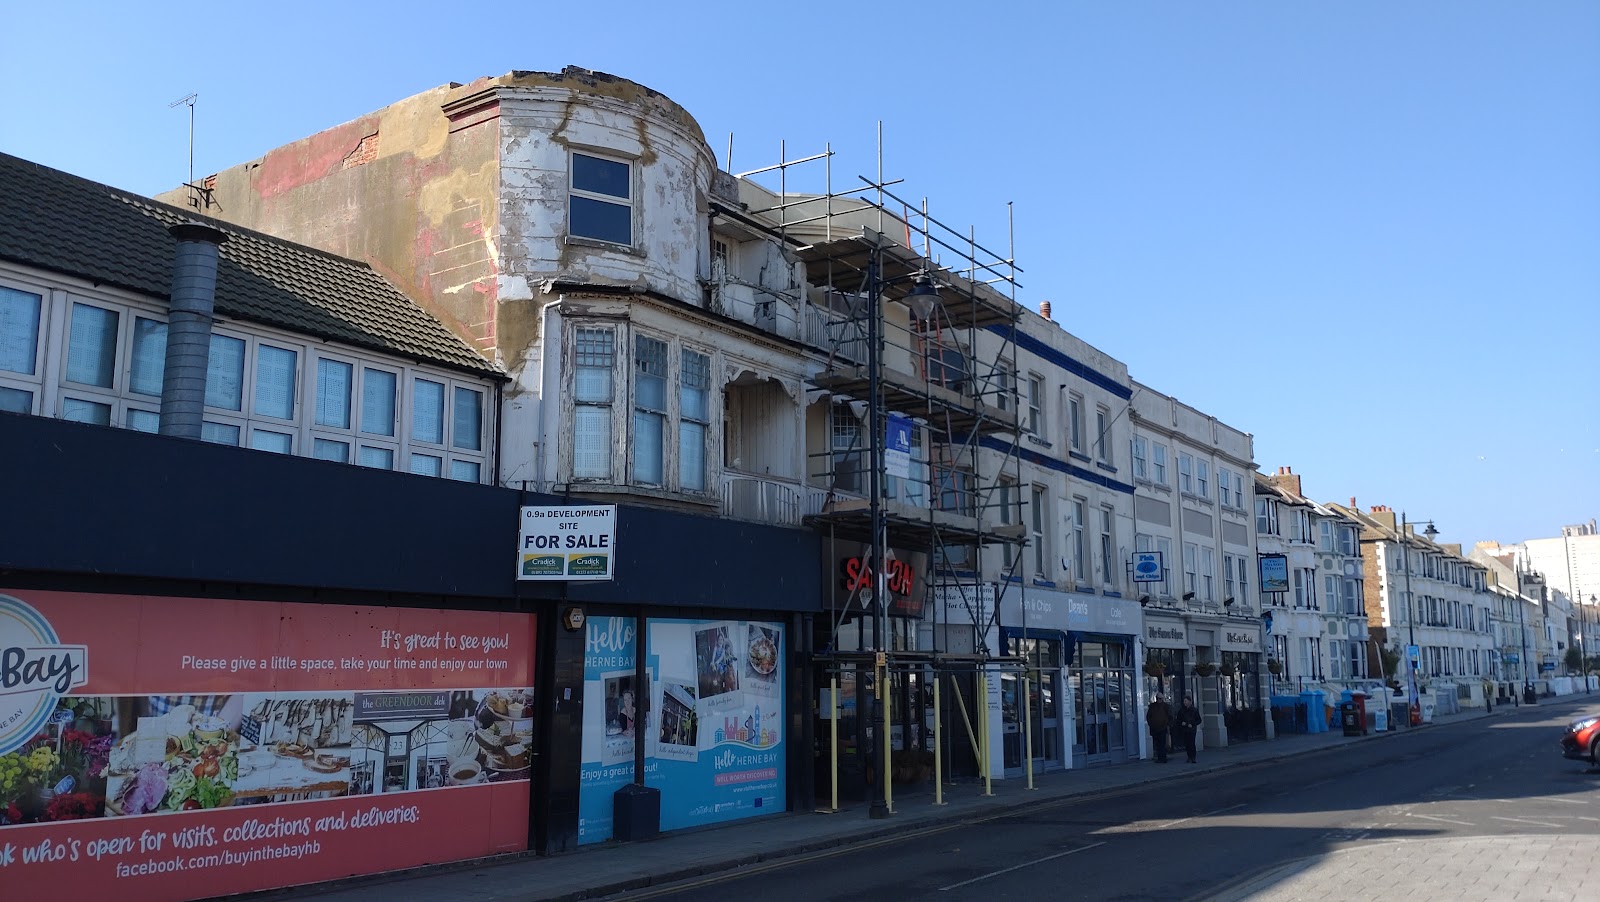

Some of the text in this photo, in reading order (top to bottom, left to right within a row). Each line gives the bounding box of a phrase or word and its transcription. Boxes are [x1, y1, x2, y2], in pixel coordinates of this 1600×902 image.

[526, 509, 610, 518] 0.9a DEVELOPMENT
[558, 522, 578, 530] SITE
[524, 534, 609, 549] FOR SALE
[846, 557, 915, 597] SAON
[380, 630, 509, 654] It's great to see you!
[586, 616, 637, 654] Hello
[182, 655, 227, 670] Please
[230, 656, 257, 673] give
[259, 659, 267, 670] a
[271, 656, 297, 670] little
[341, 656, 364, 670] take
[367, 659, 391, 673] your
[393, 657, 417, 670] time
[418, 657, 438, 669] and
[440, 657, 466, 672] enjoy
[467, 659, 484, 669] our
[486, 658, 508, 669] town
[585, 656, 635, 667] HERNE BAY
[362, 698, 374, 709] the
[375, 695, 433, 708] GREENDOOR
[9, 708, 23, 723] BAY
[393, 741, 403, 750] 23
[714, 749, 777, 770] Hello HERNE BAY
[581, 769, 602, 781] Enjoy
[603, 769, 608, 777] a
[609, 766, 628, 778] great
[643, 762, 658, 773] out!
[729, 774, 747, 782] WORTH
[22, 837, 81, 864] who's
[86, 836, 136, 861] open
[138, 829, 166, 853] for
[223, 816, 311, 843] collections
[314, 810, 349, 832] and
[350, 805, 420, 829] deliveries:
[116, 840, 321, 878] facebook.com/buyinthebayhb
